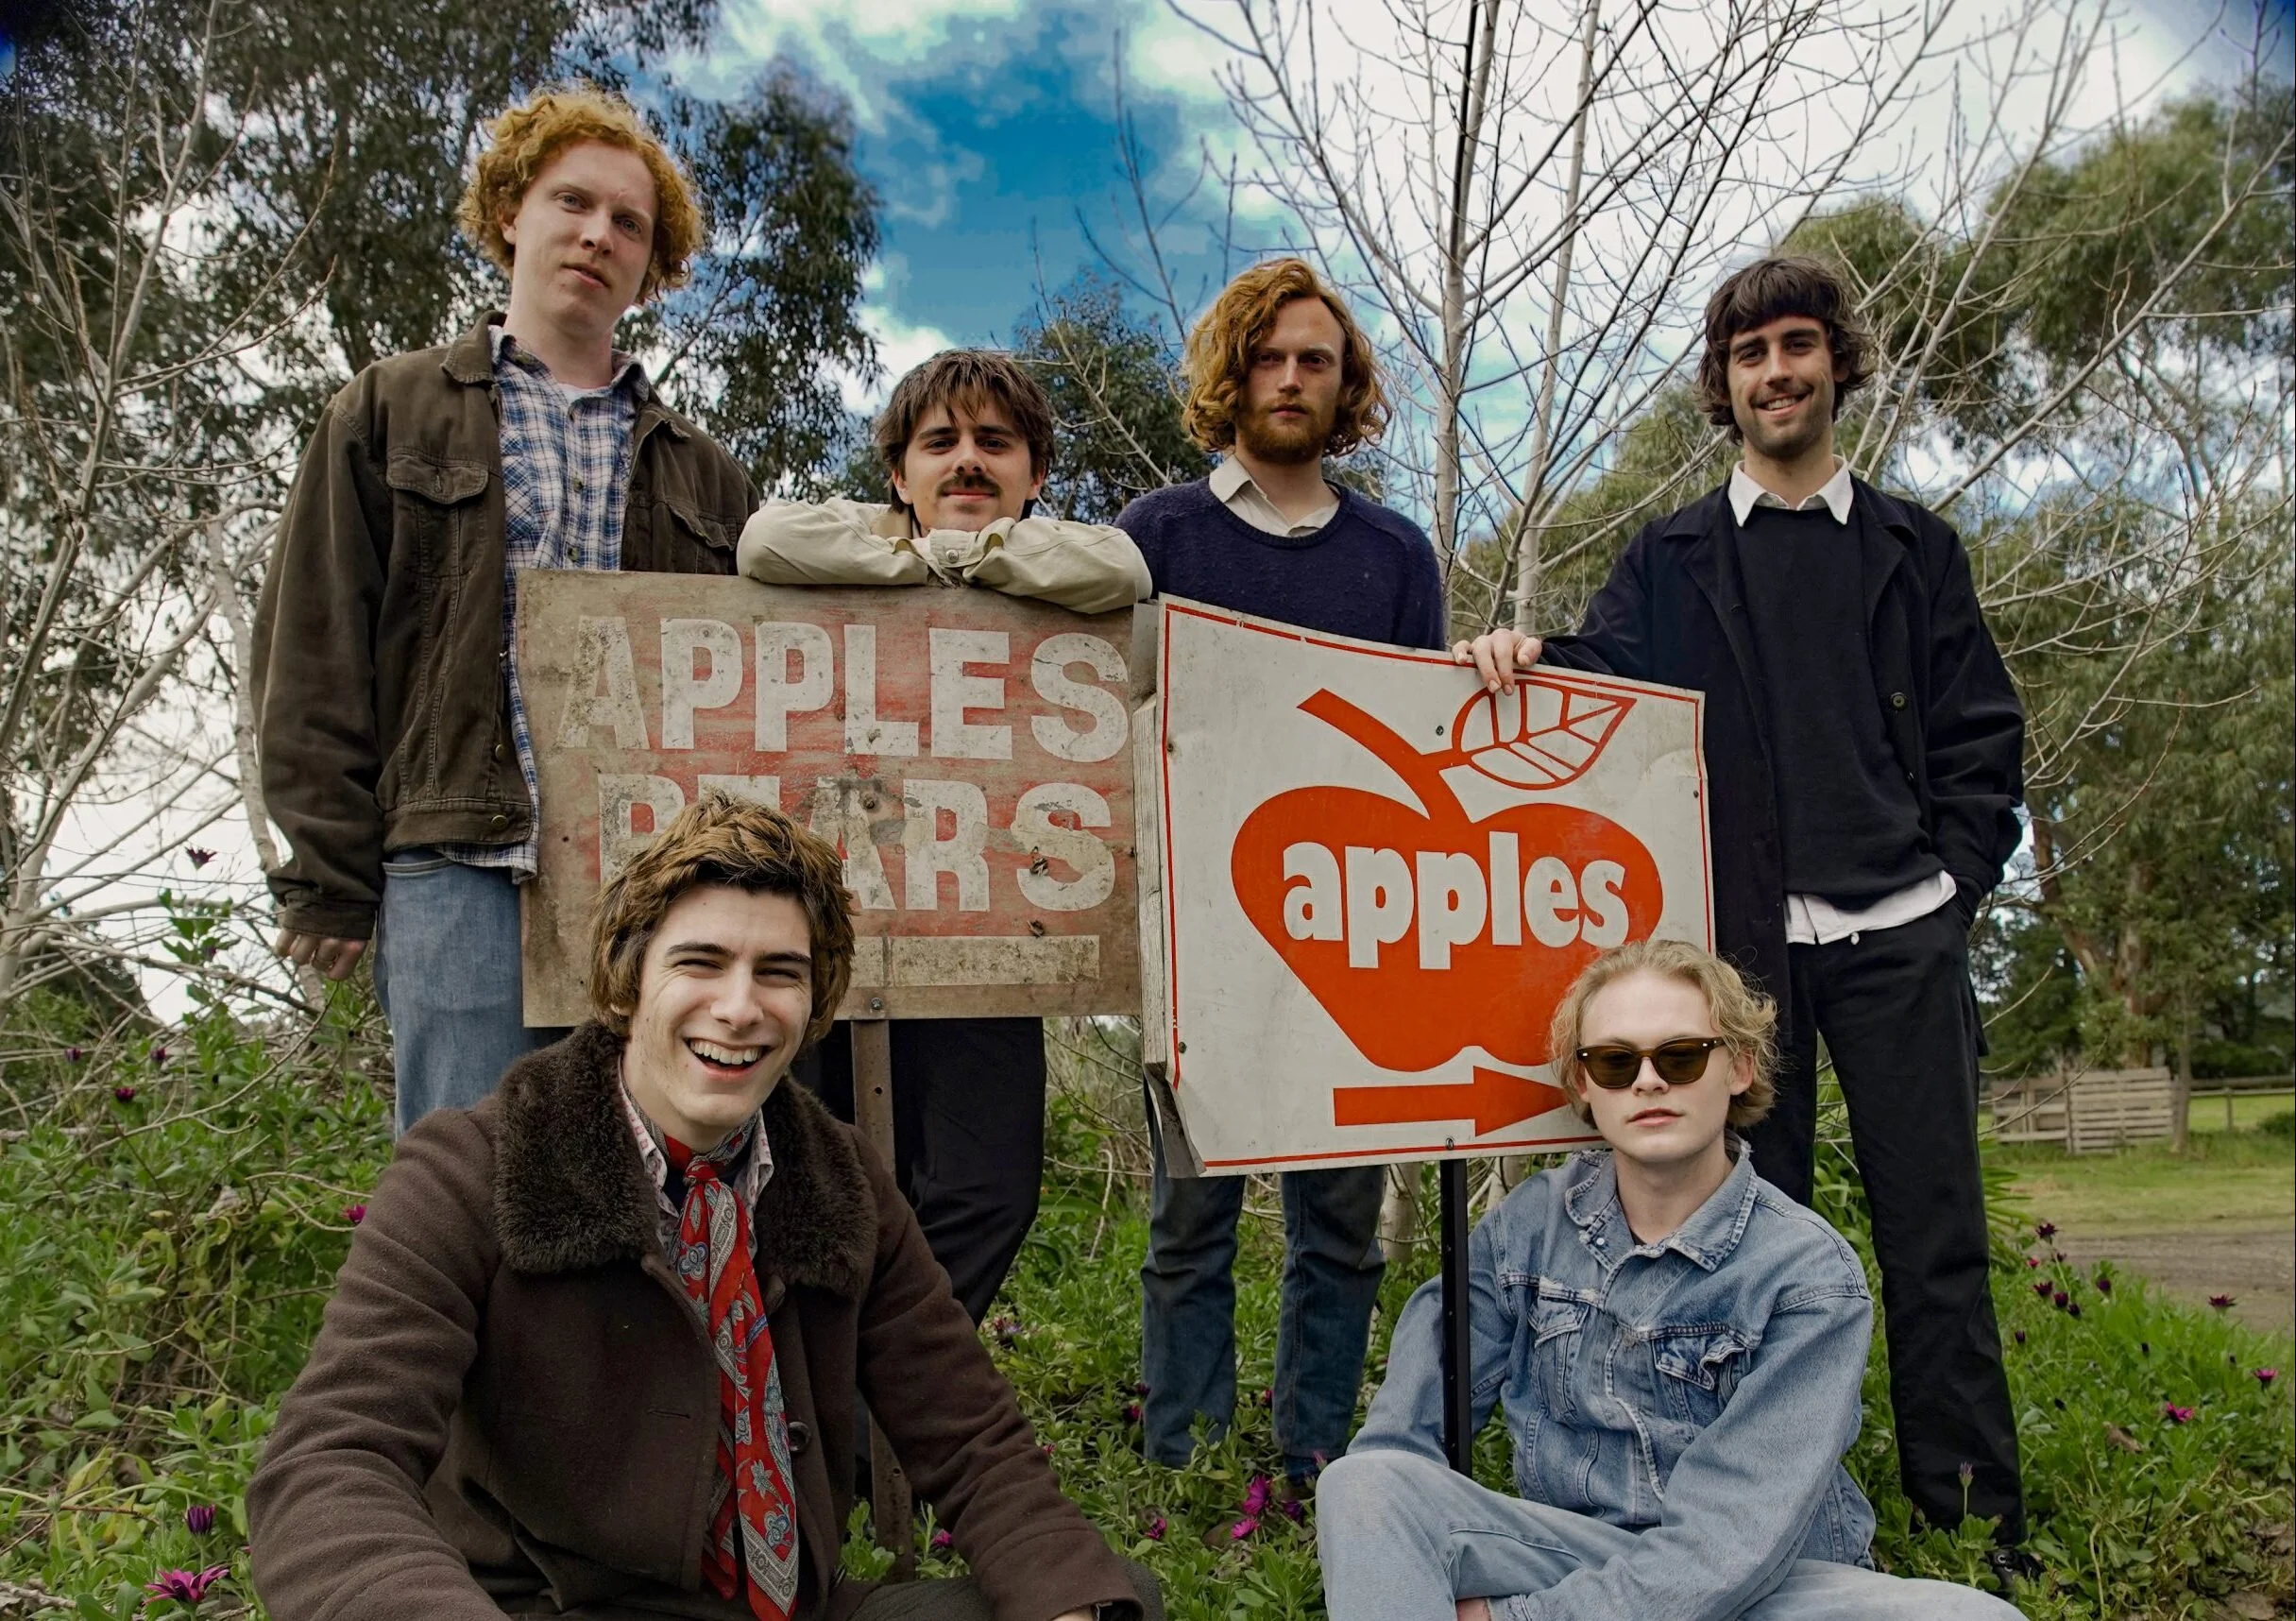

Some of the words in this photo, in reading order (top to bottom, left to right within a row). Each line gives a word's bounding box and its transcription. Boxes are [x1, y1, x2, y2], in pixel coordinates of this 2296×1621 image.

[556, 615, 1129, 763] APPLES
[597, 773, 1115, 913] PARS
[1283, 830, 1630, 970] apples
